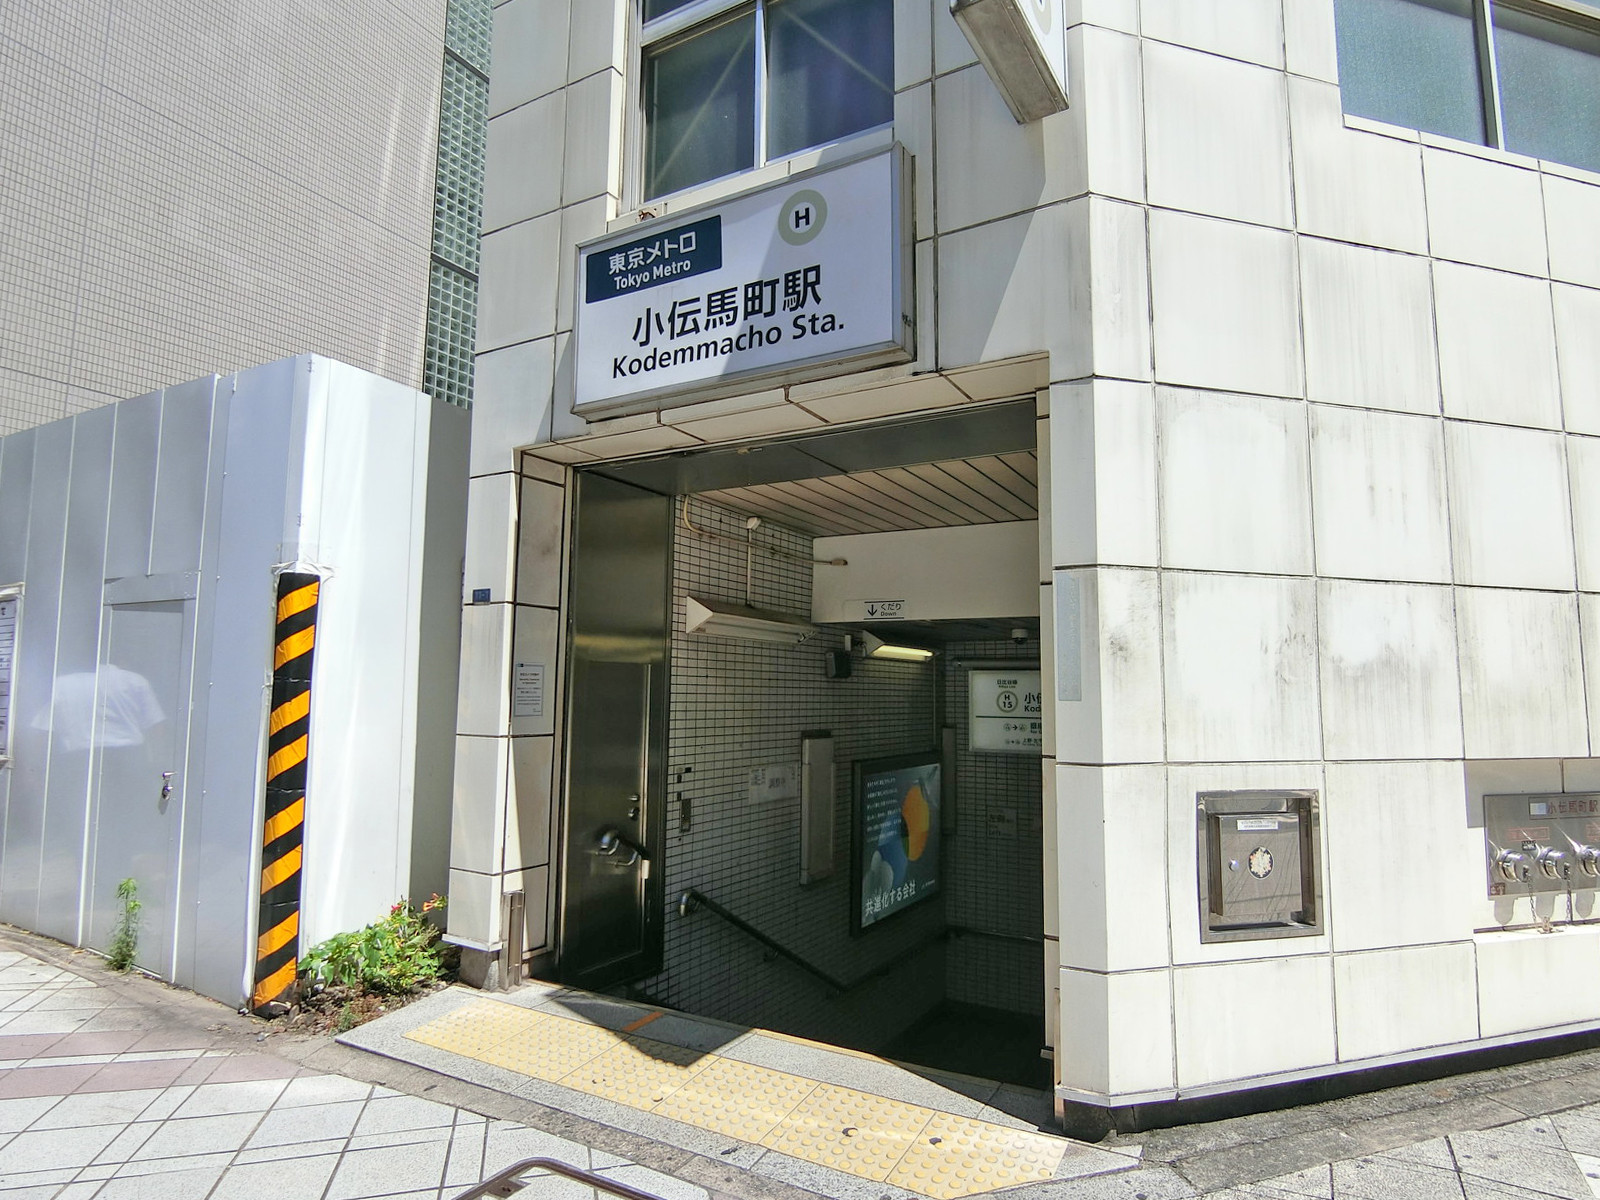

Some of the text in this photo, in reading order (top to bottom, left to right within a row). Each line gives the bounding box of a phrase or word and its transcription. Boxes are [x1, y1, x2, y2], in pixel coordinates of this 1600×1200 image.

[794, 207, 810, 229] H
[608, 231, 696, 275] 東京メトロ
[614, 259, 691, 290] Tokyo Metro
[632, 264, 822, 347] 小伝馬町駅
[612, 313, 844, 378] Kodemmacho Sta.
[880, 603, 902, 611] くだり
